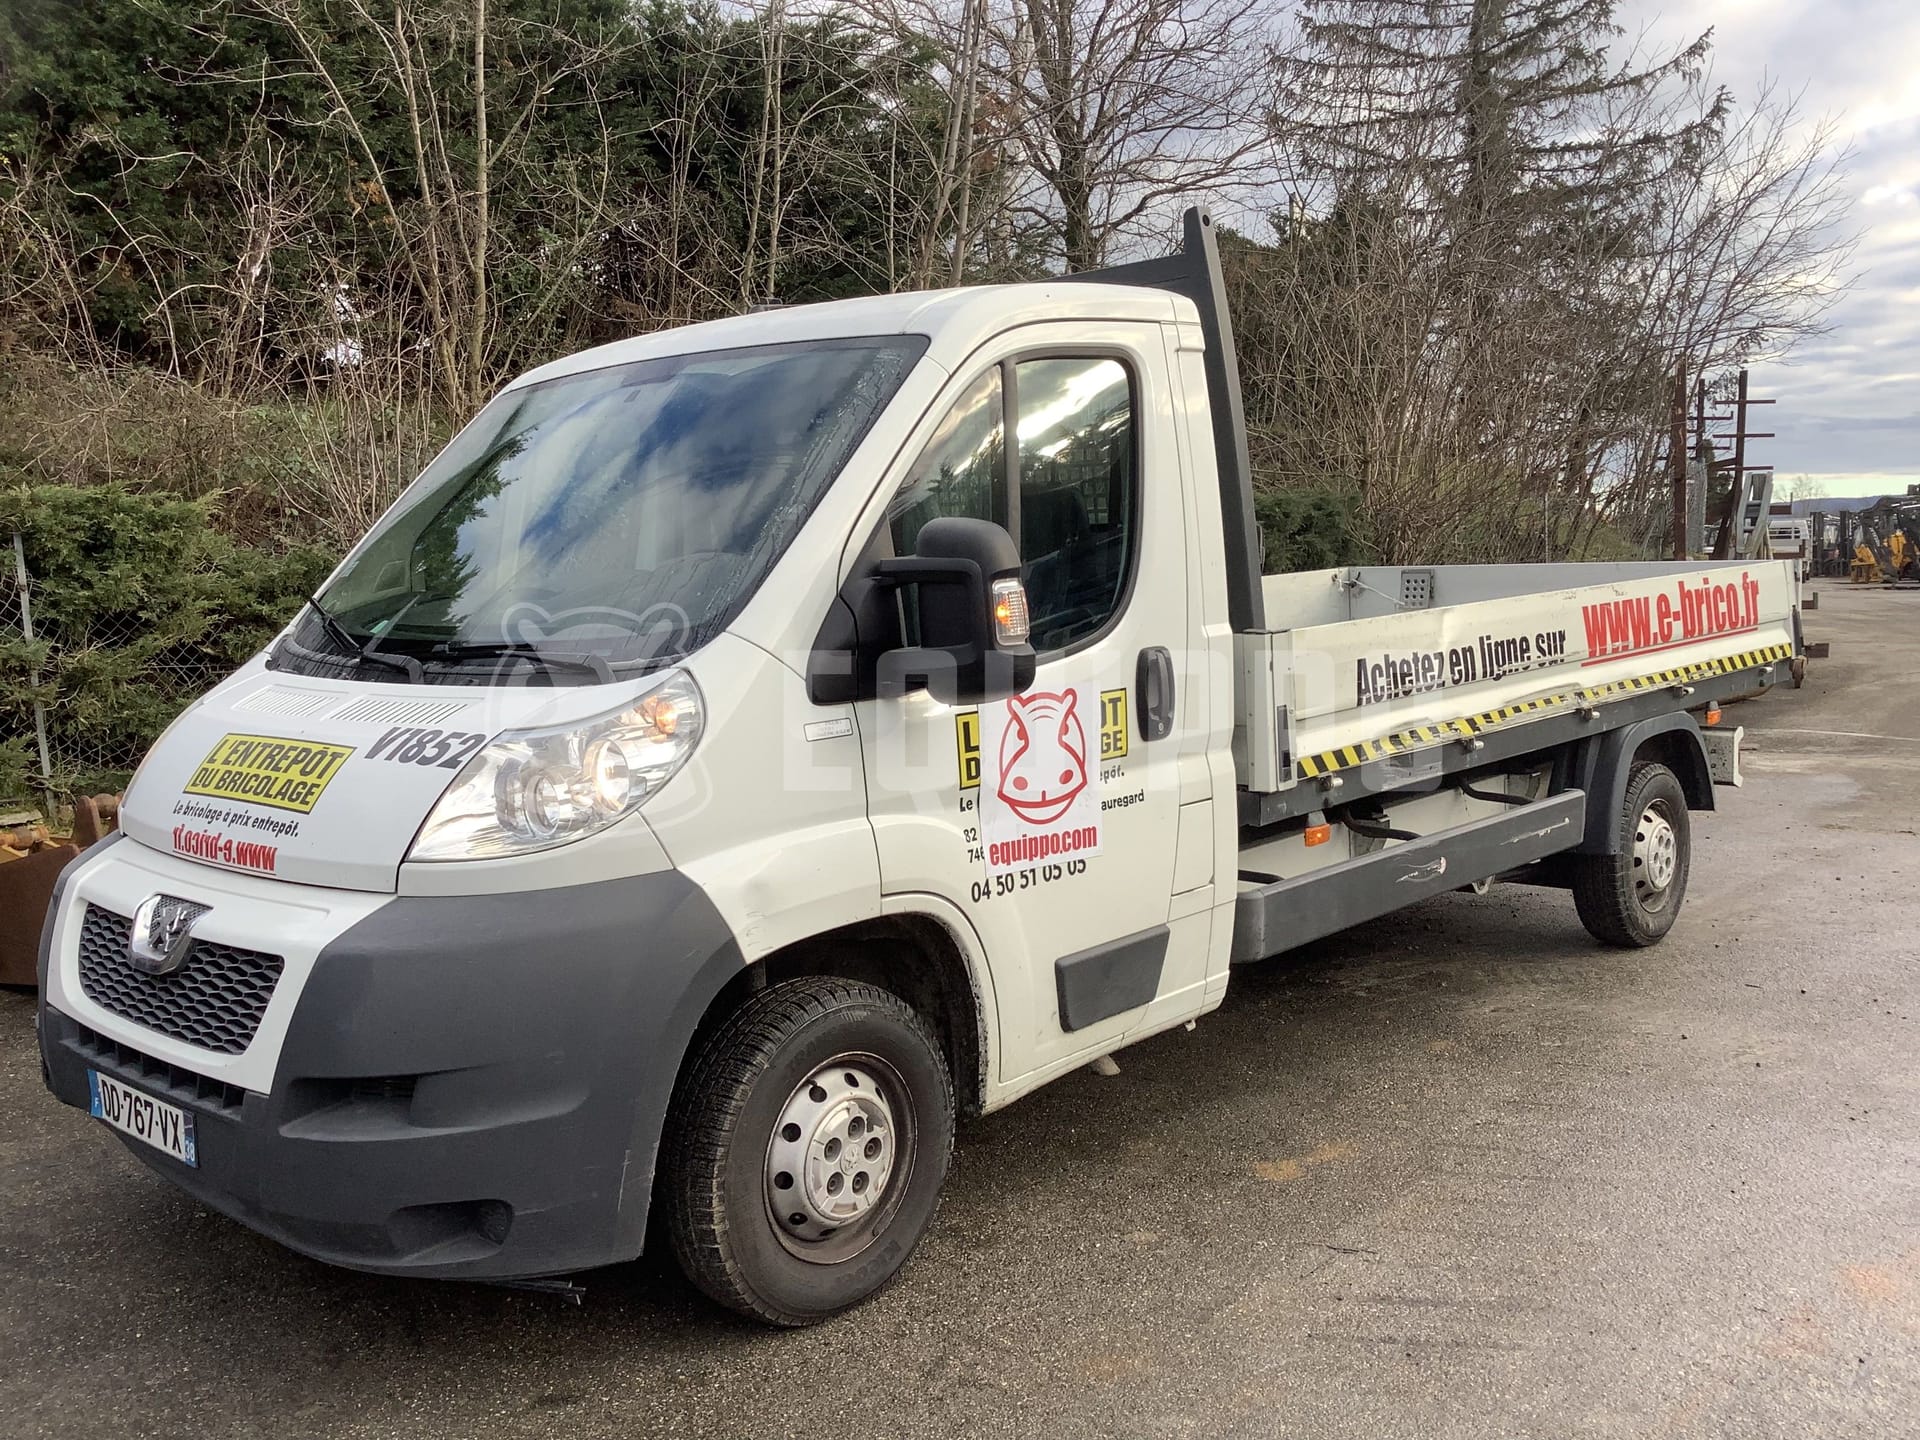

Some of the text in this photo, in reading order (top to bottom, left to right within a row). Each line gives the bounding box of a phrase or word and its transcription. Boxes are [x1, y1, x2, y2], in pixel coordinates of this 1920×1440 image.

[1582, 571, 1760, 658] www.e-brico.fr
[1357, 629, 1567, 707] Achetez en ligne sur
[206, 738, 346, 780] L'ENTREPÔT
[364, 726, 487, 770] V1852
[190, 767, 321, 806] DU BRICOLAGE
[960, 796, 973, 813] Le
[1101, 788, 1145, 812] auregard
[173, 799, 300, 838] Le bricolage à prix entrepôt.
[963, 827, 978, 843] 82
[989, 825, 1098, 866] equippo.com
[971, 858, 1087, 903] 04 50 51 05 05
